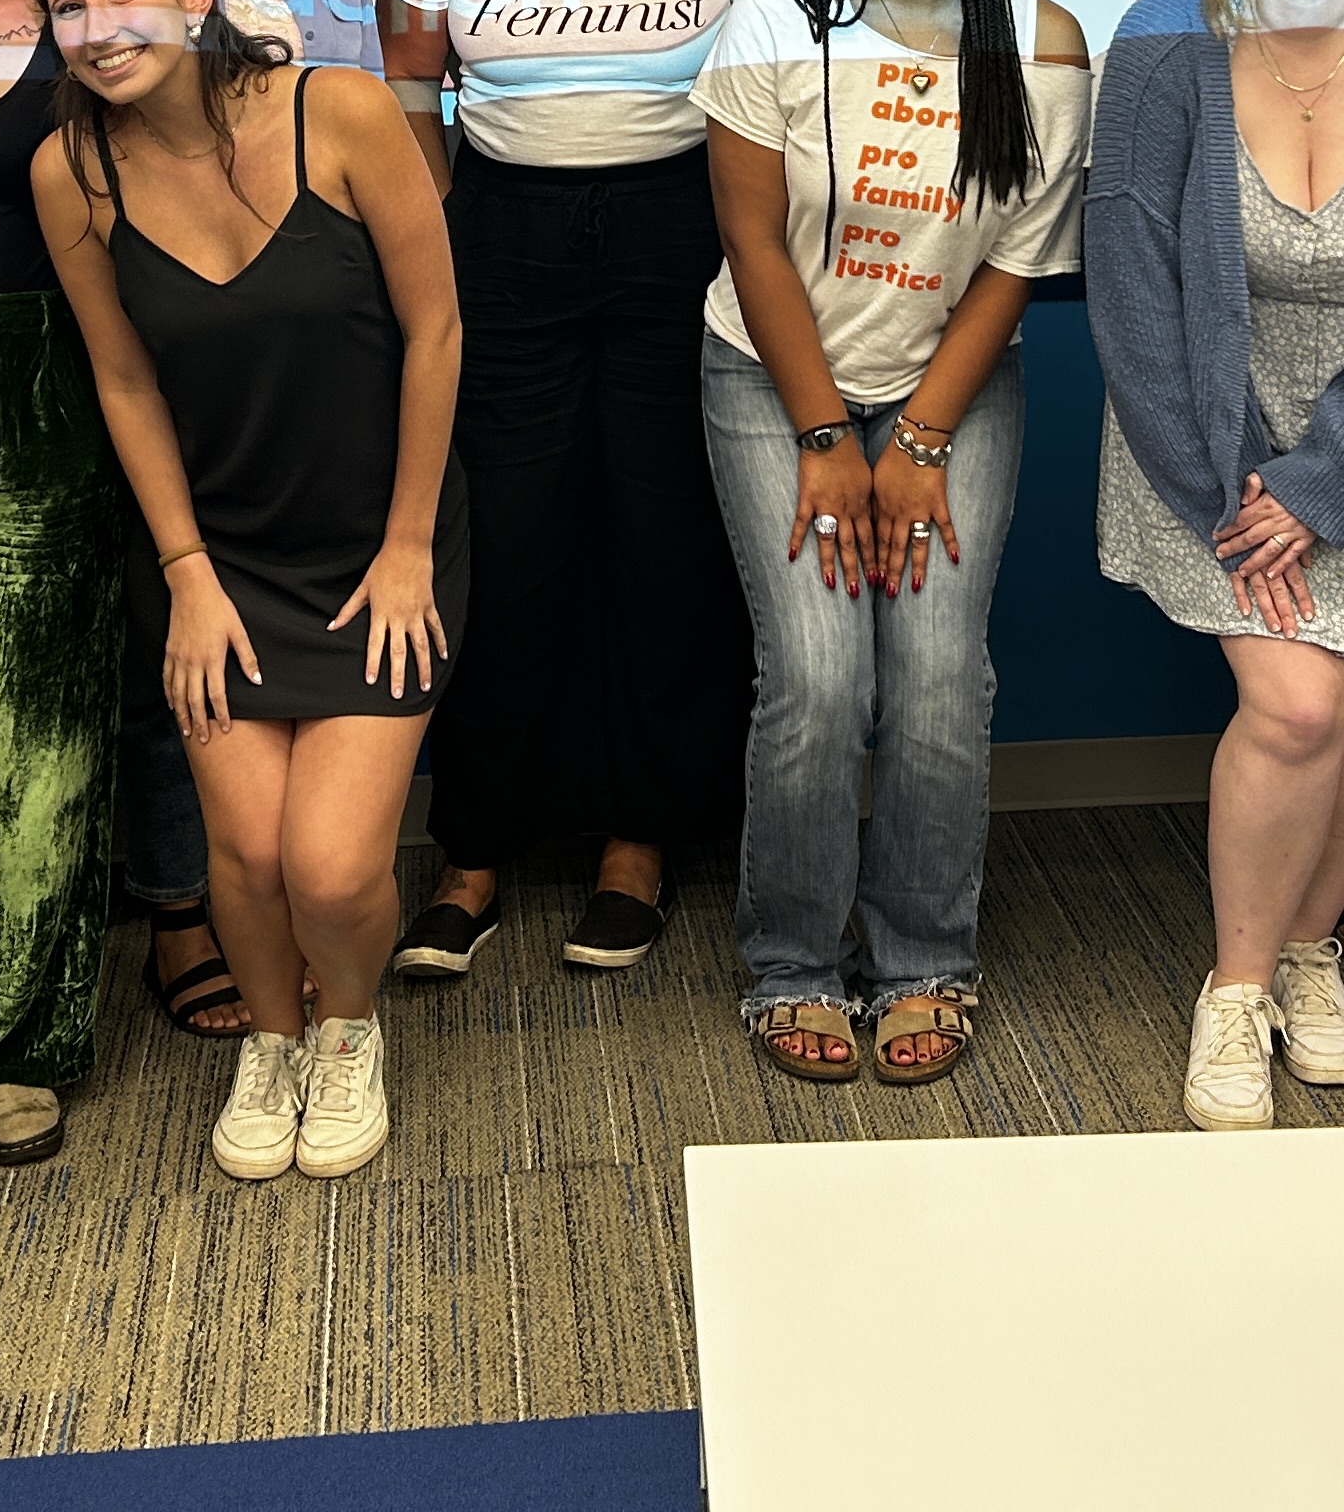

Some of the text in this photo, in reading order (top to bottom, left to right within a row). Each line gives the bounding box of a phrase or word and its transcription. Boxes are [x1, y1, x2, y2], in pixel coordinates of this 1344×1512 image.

[876, 62, 939, 88] pro
[857, 144, 918, 170] pro
[851, 175, 965, 223] family
[841, 223, 901, 248] pro
[834, 248, 943, 291] justice
